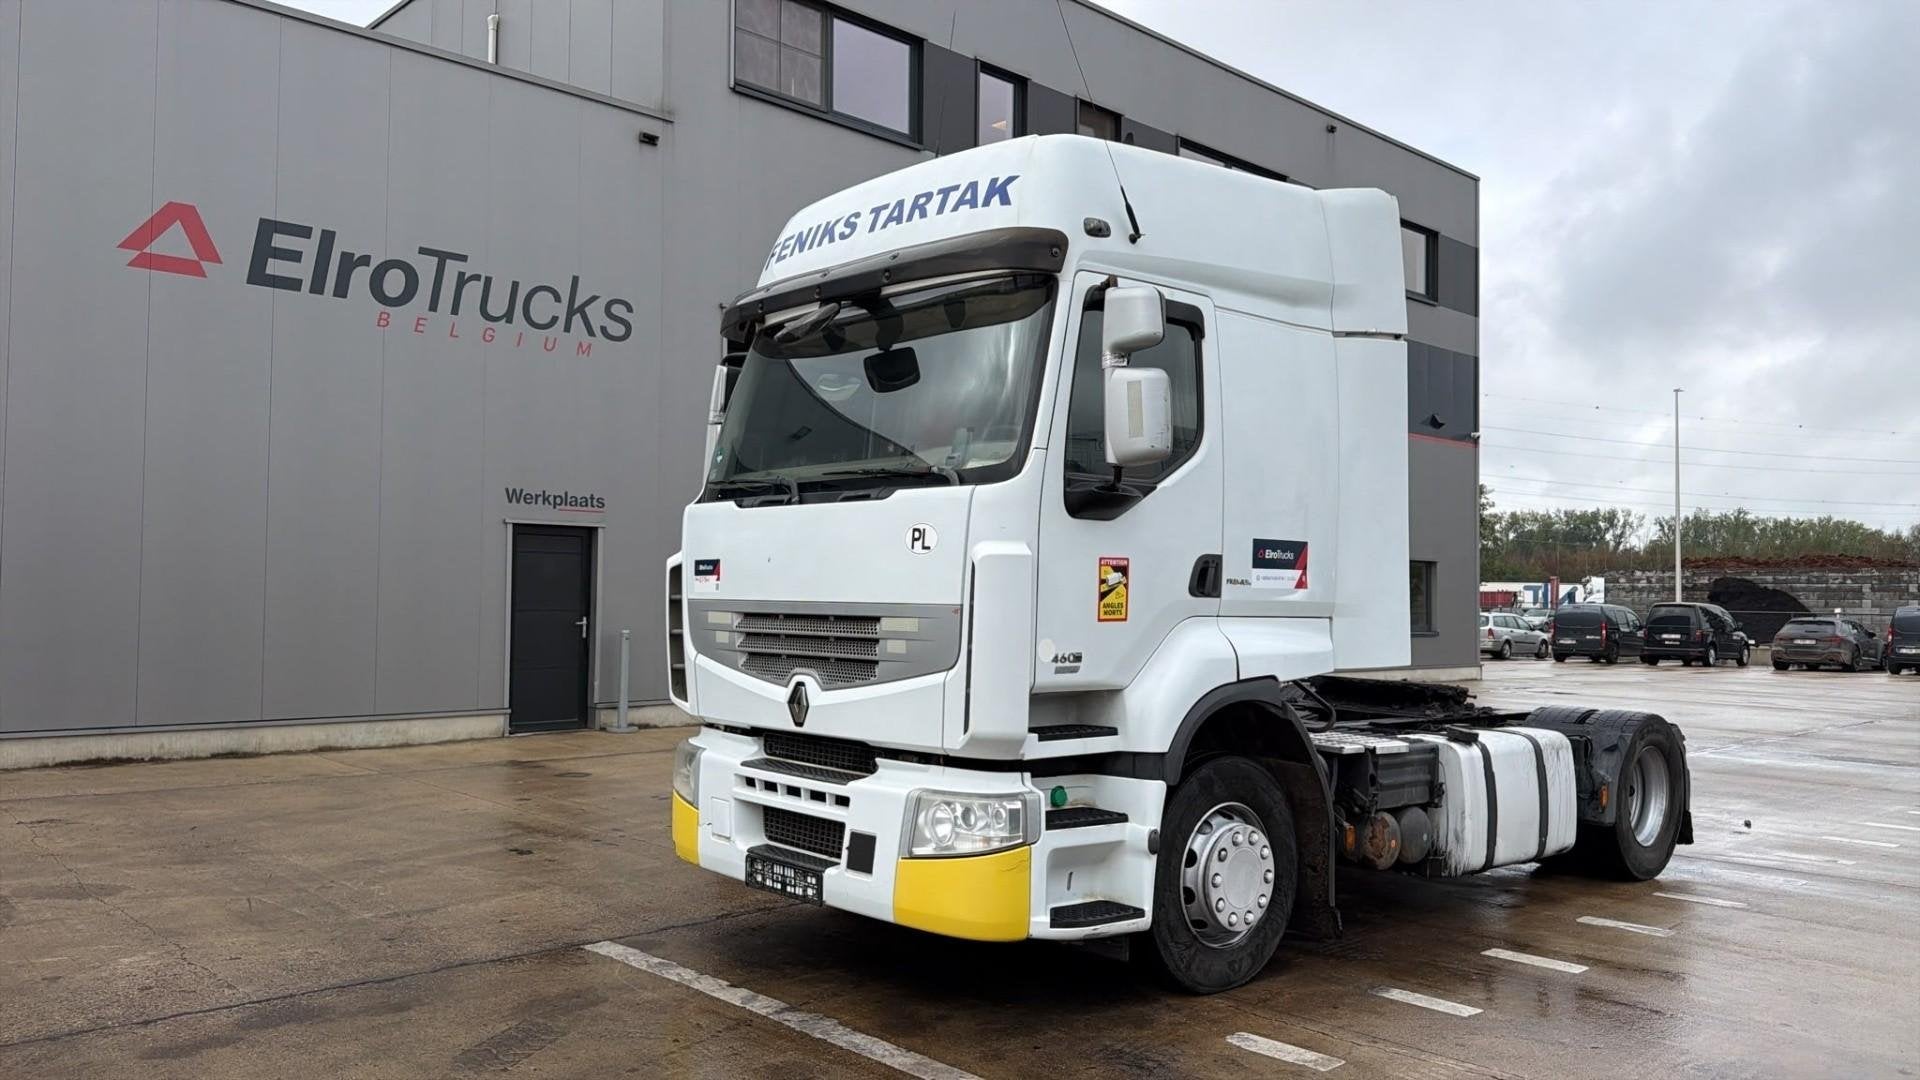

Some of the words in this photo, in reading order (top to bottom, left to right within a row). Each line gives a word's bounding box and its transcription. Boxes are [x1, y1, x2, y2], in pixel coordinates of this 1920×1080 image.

[765, 211, 861, 271] FENIKS
[868, 174, 1020, 234] TARTAK
[246, 217, 634, 343] ElroTrucks
[377, 310, 593, 357] BELGIUM
[505, 487, 606, 510] Werkplaats
[911, 527, 931, 550] PL
[1051, 653, 1075, 664] 460
